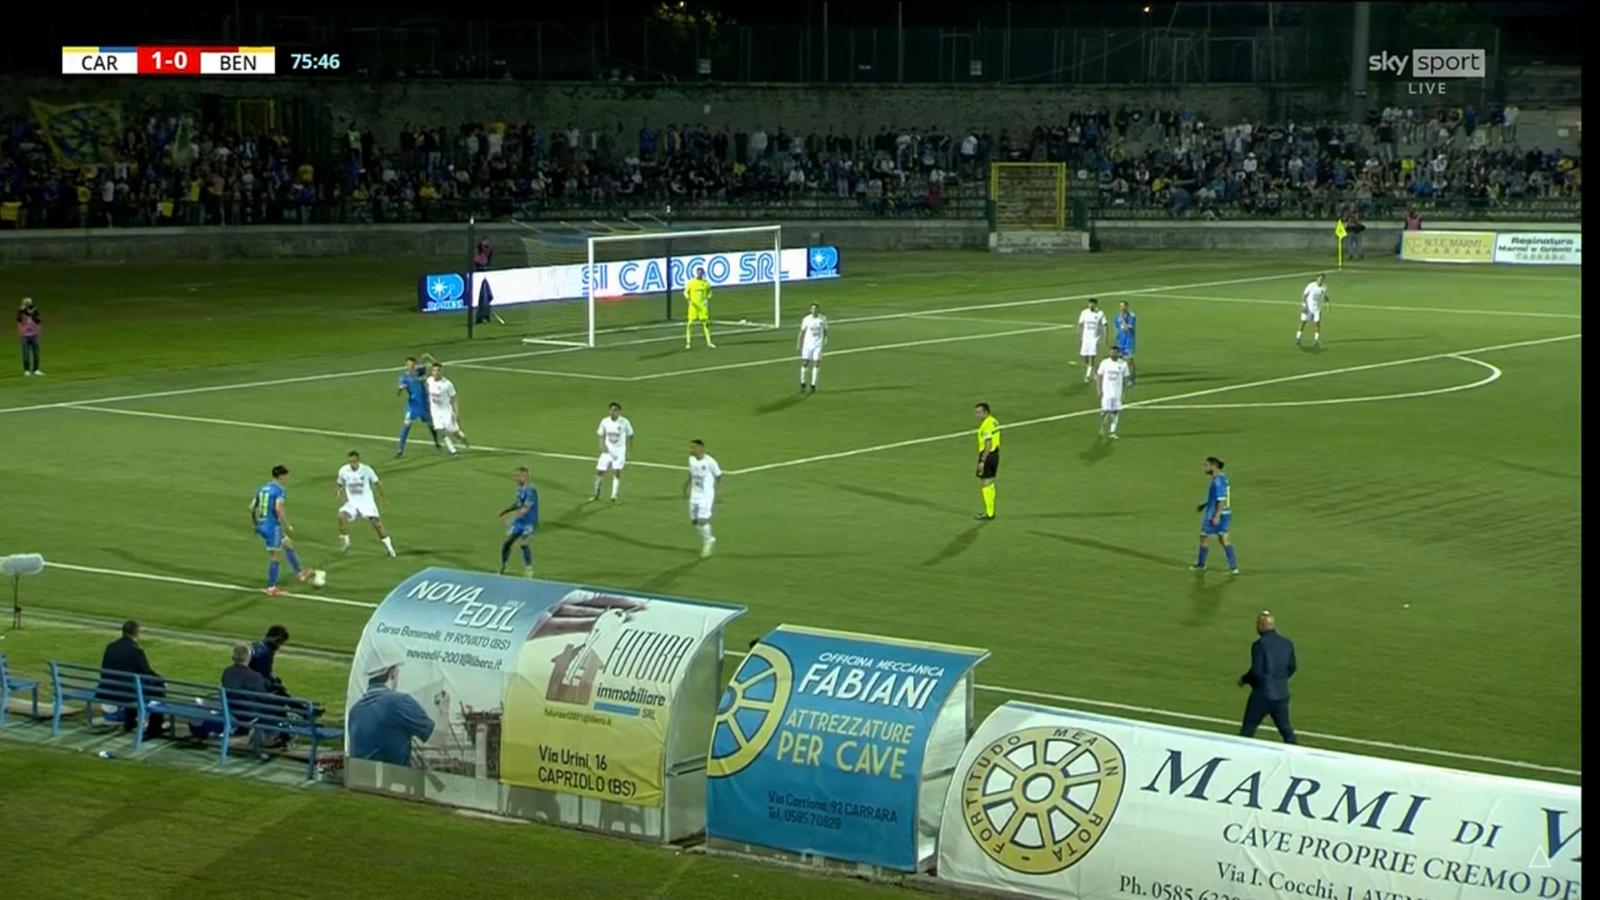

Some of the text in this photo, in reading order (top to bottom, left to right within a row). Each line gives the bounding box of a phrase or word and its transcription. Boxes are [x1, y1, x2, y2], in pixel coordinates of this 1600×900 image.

[618, 255, 731, 292] CARGO
[738, 251, 790, 282] SRL
[259, 491, 269, 518] 11
[406, 580, 485, 605] NOVA
[454, 601, 526, 633] EDIL
[443, 631, 453, 642] 19
[453, 633, 489, 649] ROVATO
[490, 638, 512, 651] (BS)
[602, 628, 695, 684] FUTURA
[819, 651, 945, 678] OFFICINA MECCANICA
[597, 683, 666, 706] immobiliare
[797, 663, 939, 711] FABIANI
[641, 708, 656, 720] SRL
[786, 708, 916, 745] ATTREZZATURE
[538, 744, 558, 763] Via
[595, 754, 608, 771] 16
[776, 730, 908, 780] PER CAVE
[538, 766, 637, 797] CAPRIOLO (BS)
[966, 728, 1120, 862] FORTITUDO MEA IN ROTA
[768, 790, 785, 804] Via
[831, 800, 844, 815] 92
[845, 803, 898, 823] CARRARA
[1140, 748, 1431, 836] MARMI
[1452, 819, 1504, 849] DI
[784, 809, 810, 825] 0585
[1222, 822, 1292, 853] CAVE
[1297, 835, 1417, 876] PROPRIE
[1423, 857, 1532, 894] CREMO
[1119, 874, 1147, 896] Ph.
[1151, 880, 1194, 900] 0585
[1217, 860, 1246, 884] Via
[1249, 867, 1263, 887] I.
[1268, 871, 1338, 900] Cocchi,
